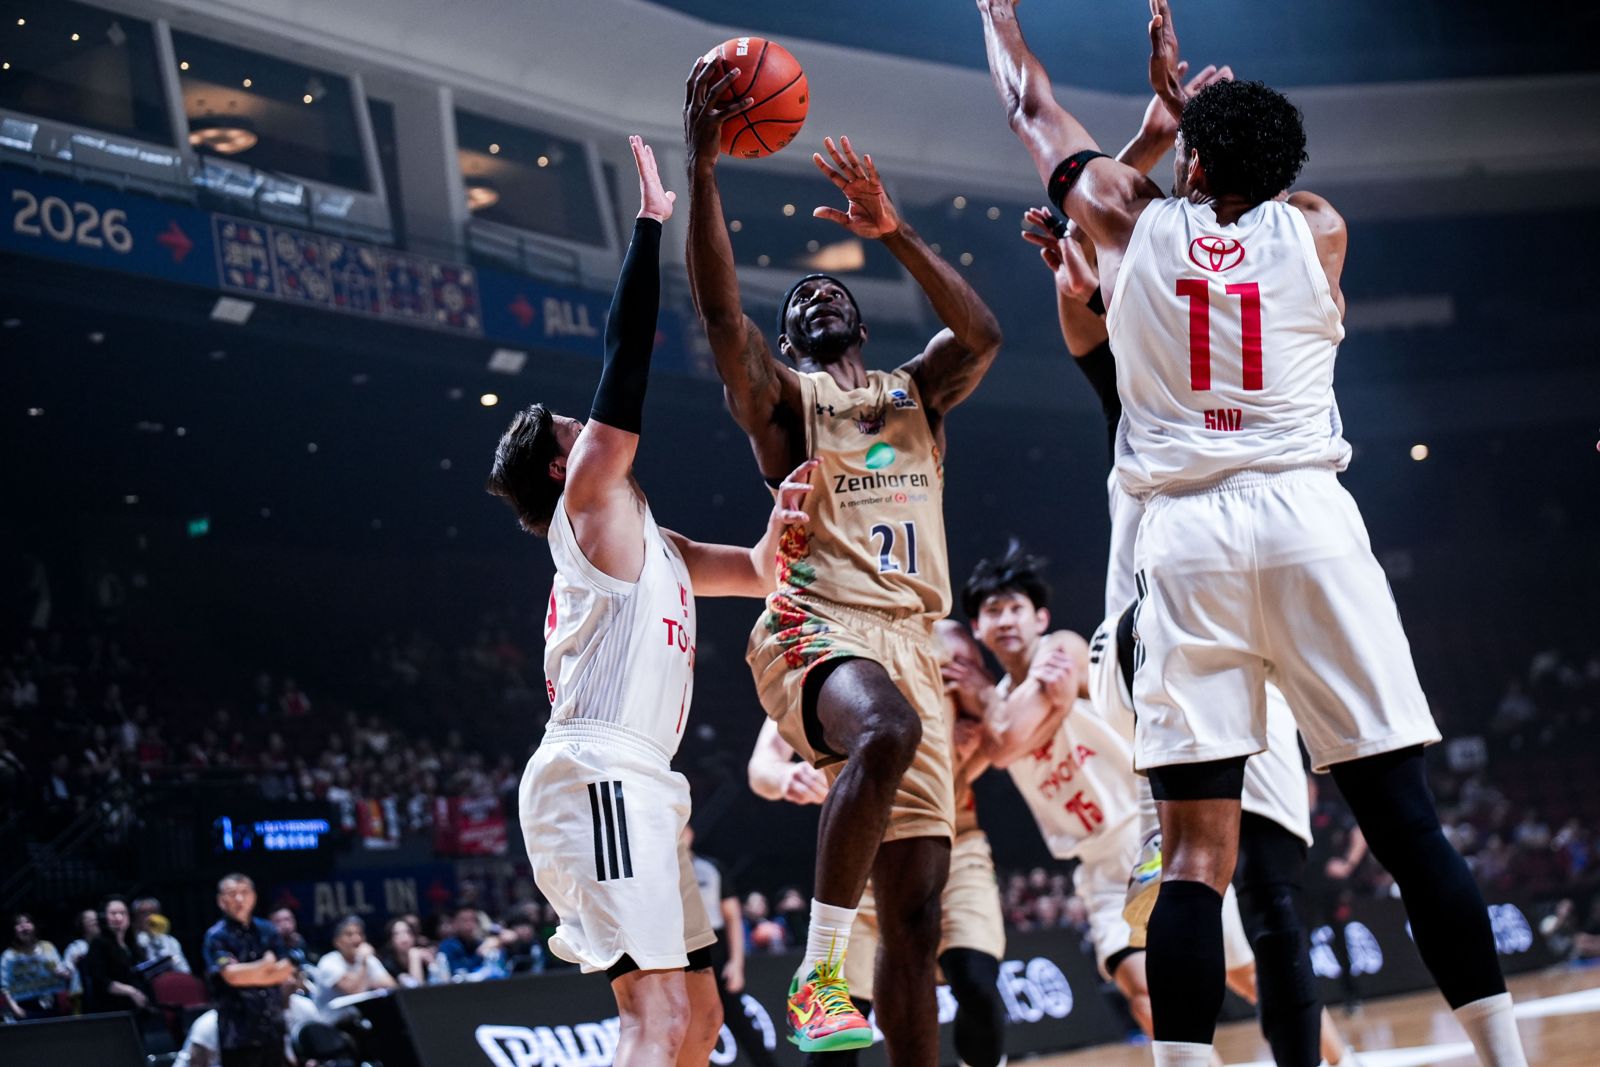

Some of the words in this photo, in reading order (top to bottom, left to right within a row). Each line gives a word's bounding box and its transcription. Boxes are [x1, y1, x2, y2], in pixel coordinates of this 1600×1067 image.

[12, 189, 134, 253] 2026
[543, 297, 600, 337] ALL
[1175, 279, 1264, 391] 11
[1204, 409, 1244, 431] SAIZ
[840, 500, 847, 509] A
[848, 496, 883, 508] member
[885, 495, 893, 503] of
[869, 520, 920, 576] 21
[314, 880, 376, 926] ALL
[383, 876, 420, 914] IN
